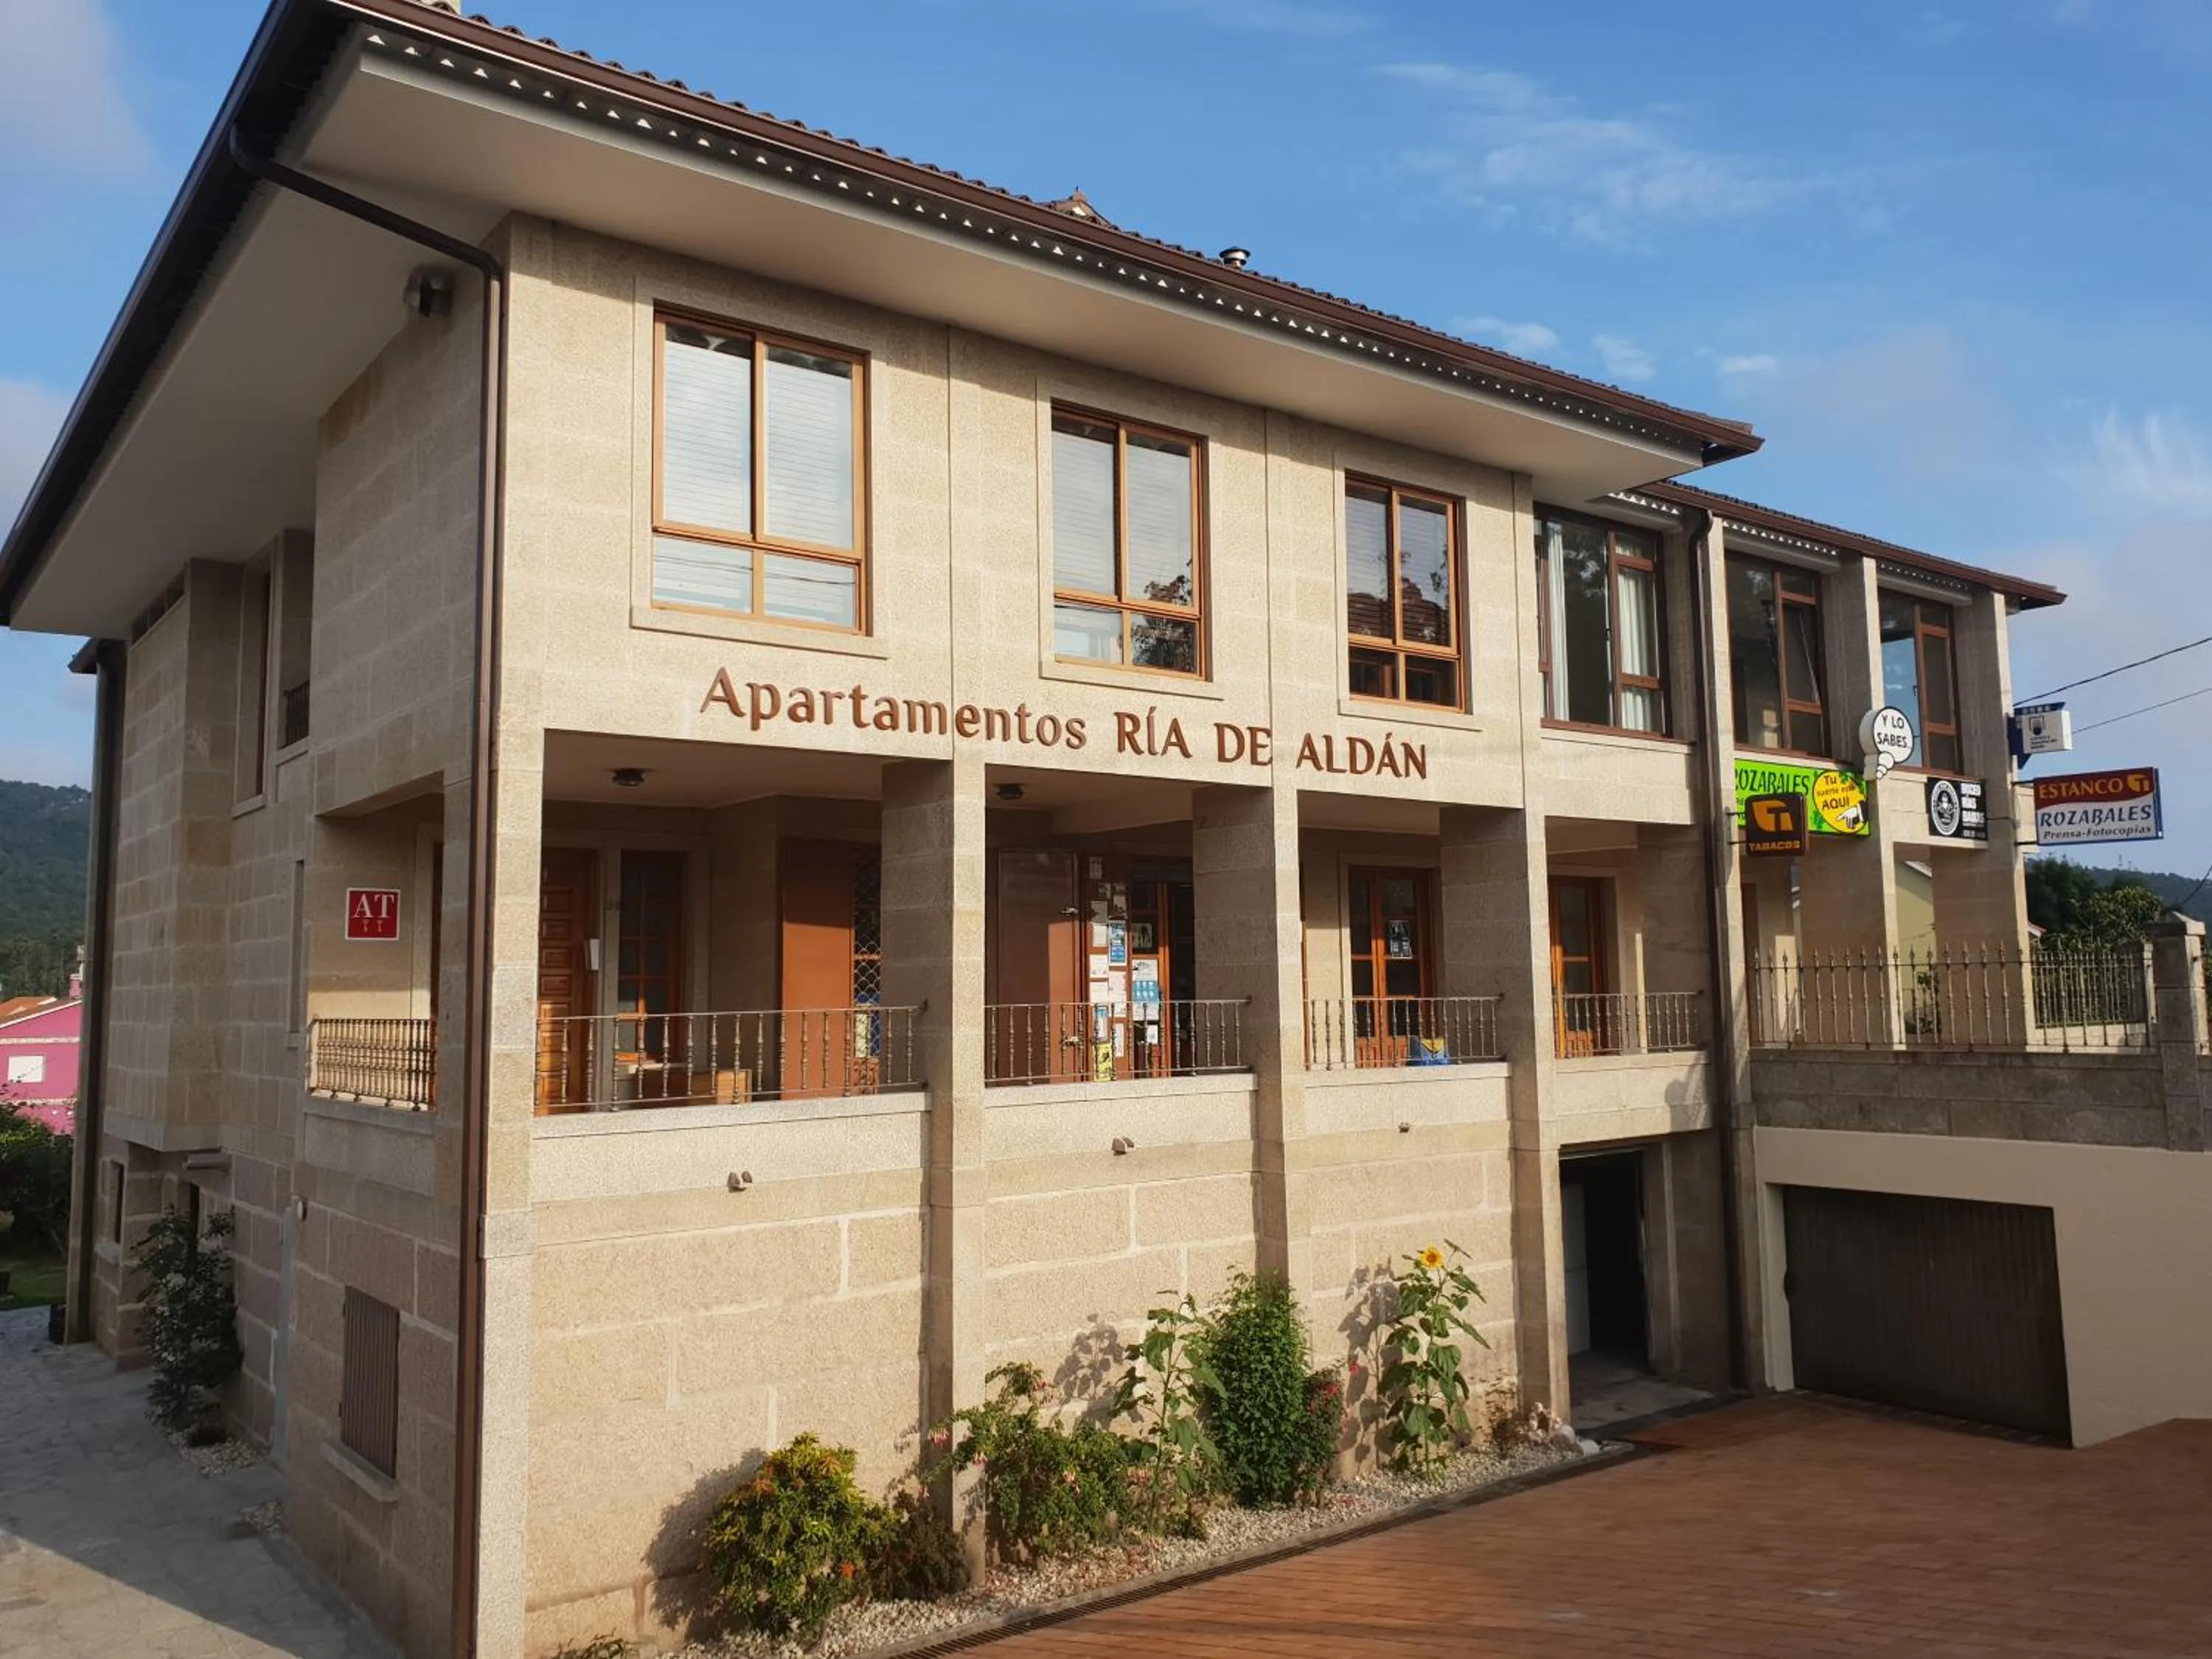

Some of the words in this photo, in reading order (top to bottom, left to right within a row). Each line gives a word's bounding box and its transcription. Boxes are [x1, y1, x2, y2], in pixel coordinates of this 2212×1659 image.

[699, 666, 1087, 750] Apartamentos
[1113, 706, 1193, 759] RÍA
[1214, 722, 1273, 766] DE
[1295, 731, 1427, 779] ALDÁN
[1881, 714, 1888, 727] Y
[1891, 716, 1905, 729] LO
[1735, 768, 1809, 796] OZABALES
[2039, 778, 2124, 799] ESTANCO
[2040, 804, 2152, 827] ROZABALES
[351, 893, 395, 919] AT
